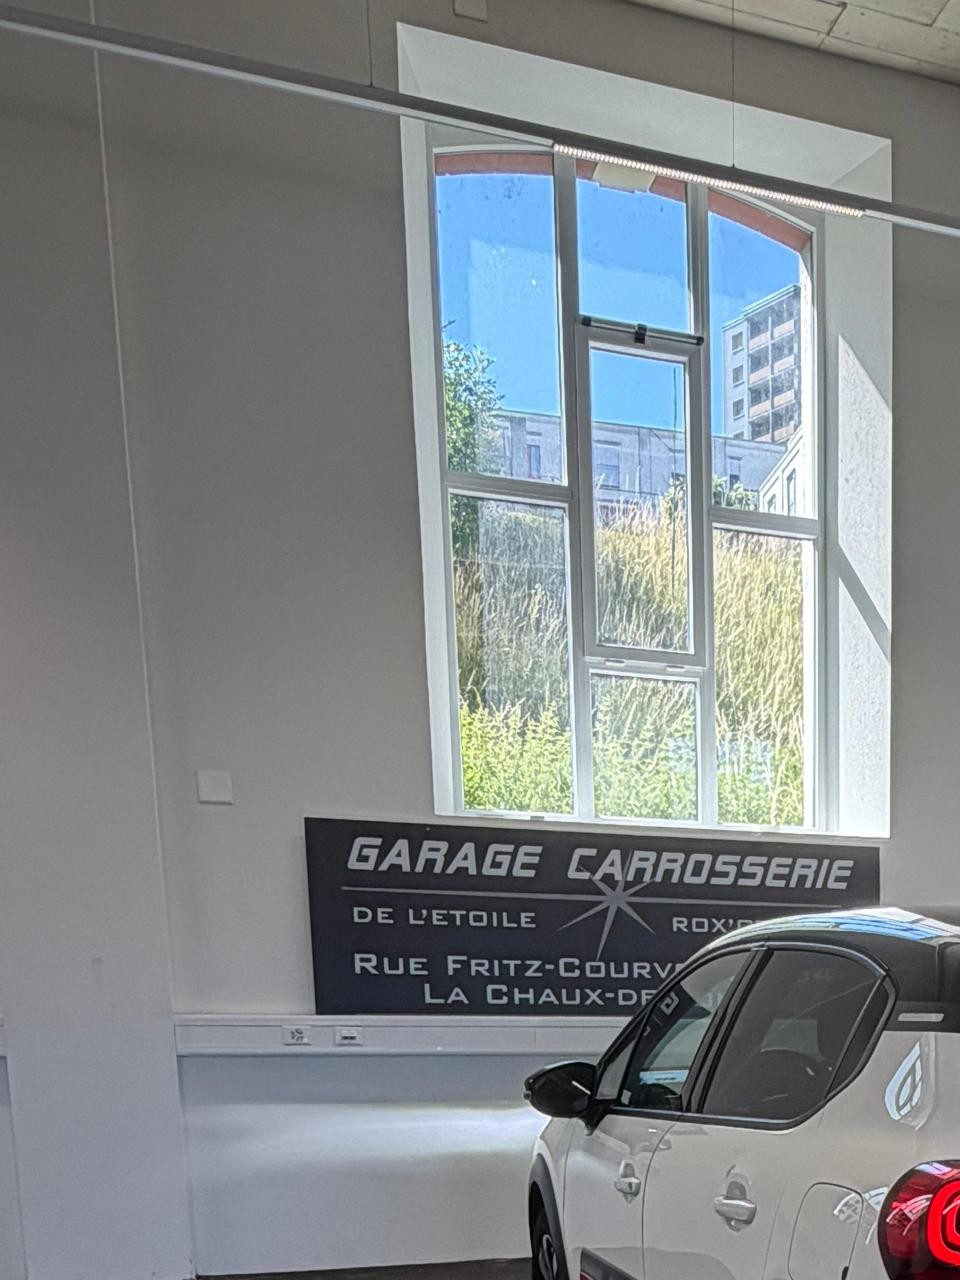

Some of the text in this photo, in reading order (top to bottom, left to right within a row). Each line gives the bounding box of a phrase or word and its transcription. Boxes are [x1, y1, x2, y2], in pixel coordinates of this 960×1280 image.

[347, 836, 854, 890] GARAGE CARROSSERIE
[353, 906, 536, 928] DE L'ETOILE
[354, 953, 429, 976] RUE
[424, 983, 469, 1004] LA
